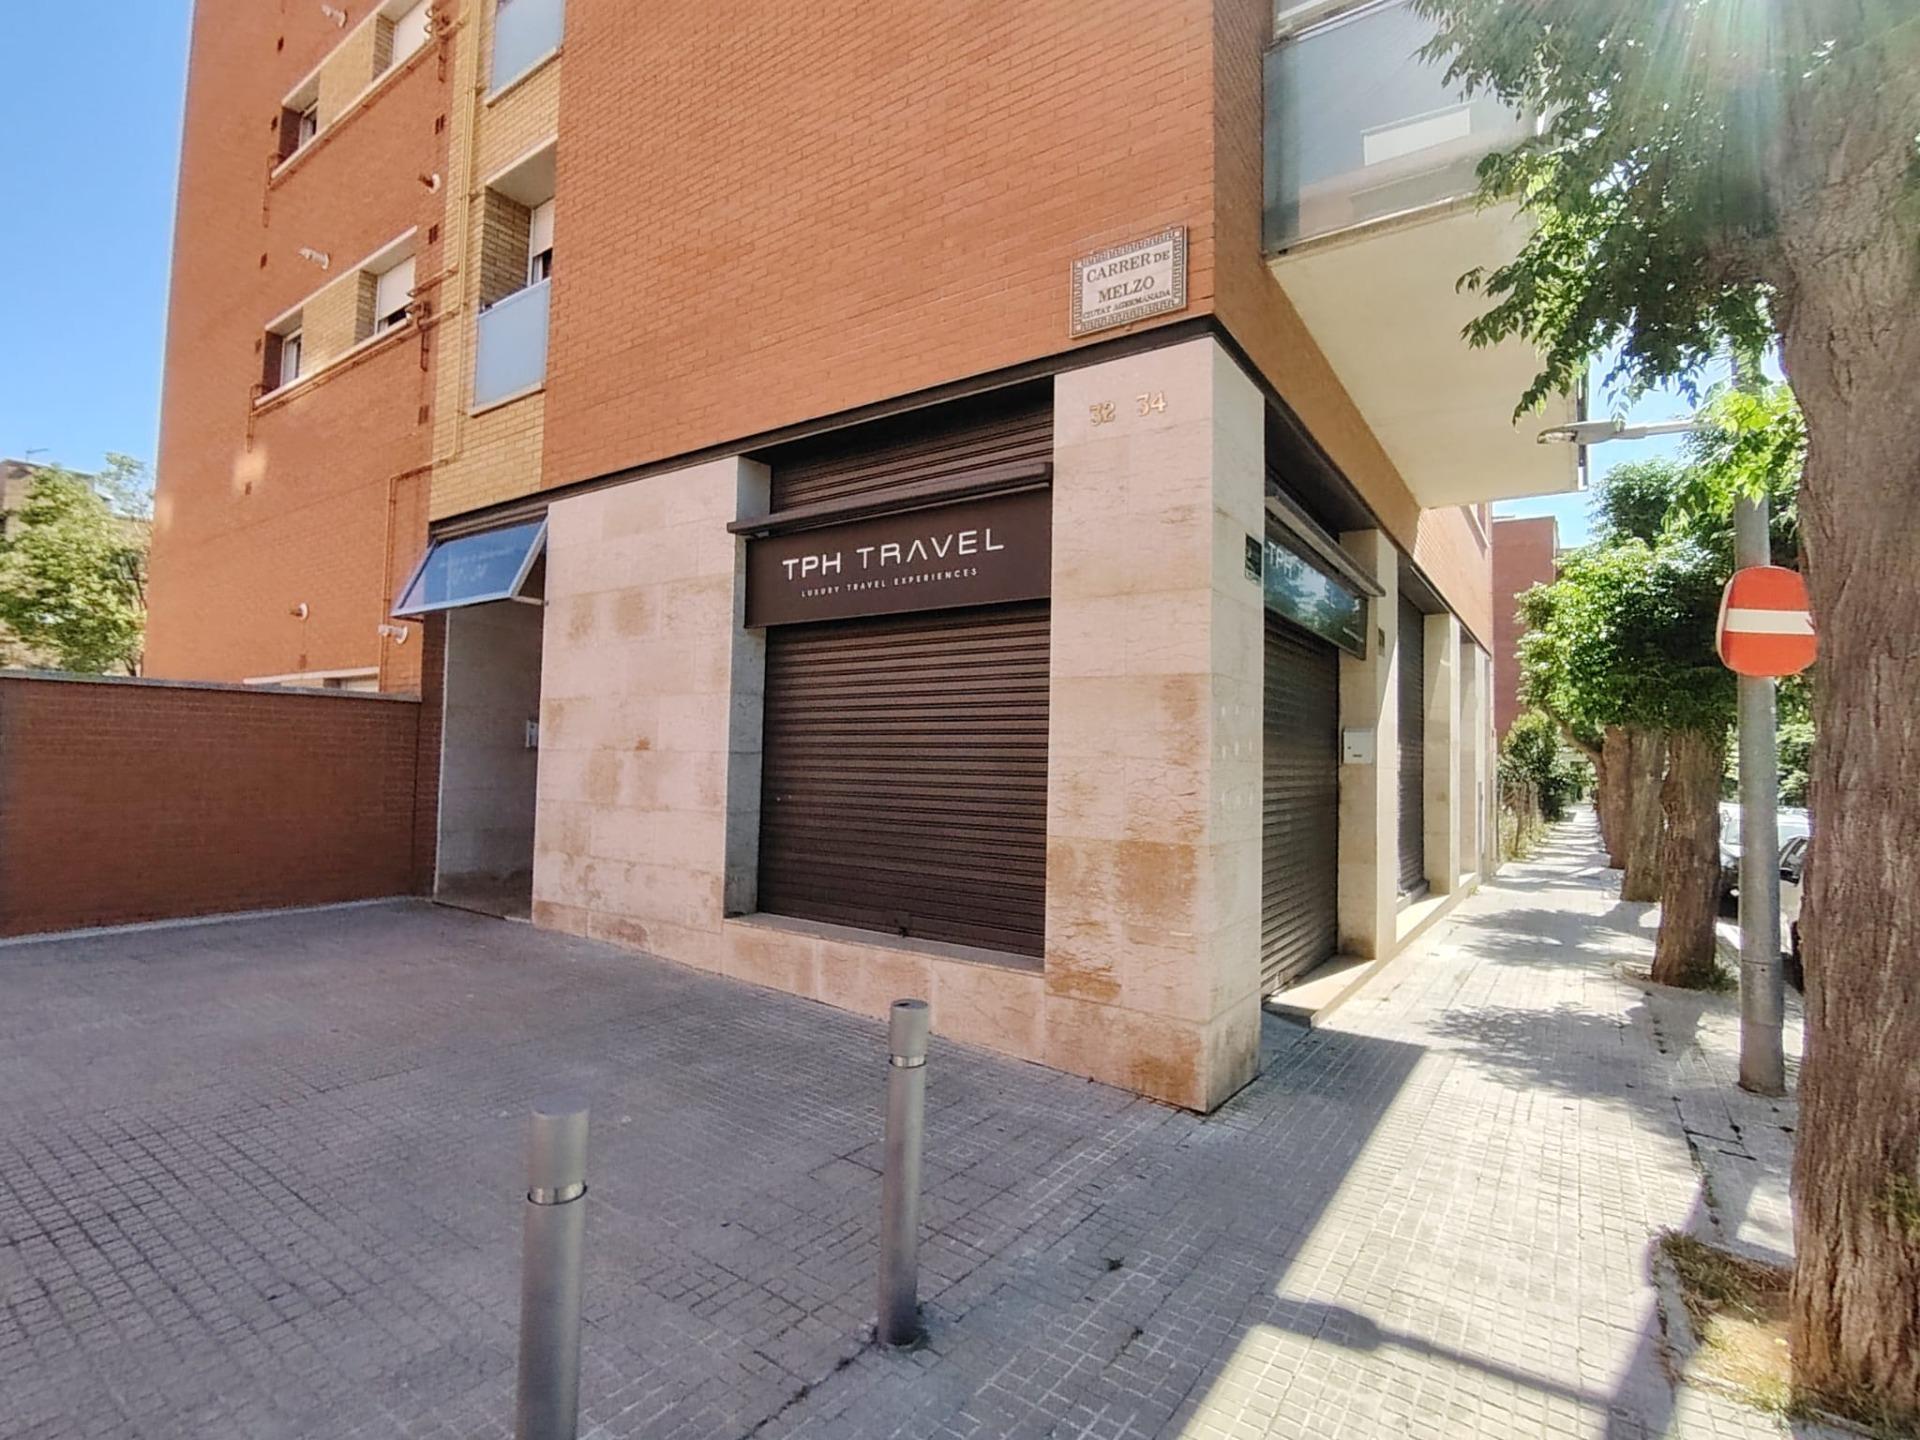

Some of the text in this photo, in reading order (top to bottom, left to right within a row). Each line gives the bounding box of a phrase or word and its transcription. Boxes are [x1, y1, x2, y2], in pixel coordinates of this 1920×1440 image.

[1087, 250, 1170, 283] CARRER DE
[1098, 276, 1155, 303] MELZO
[1083, 305, 1111, 319] CIUTAT
[1089, 391, 1168, 427] 32 34
[782, 528, 1005, 580] TPH TRAVEL
[801, 567, 978, 598] LUXURY TRAVEL EXPERIENCES
